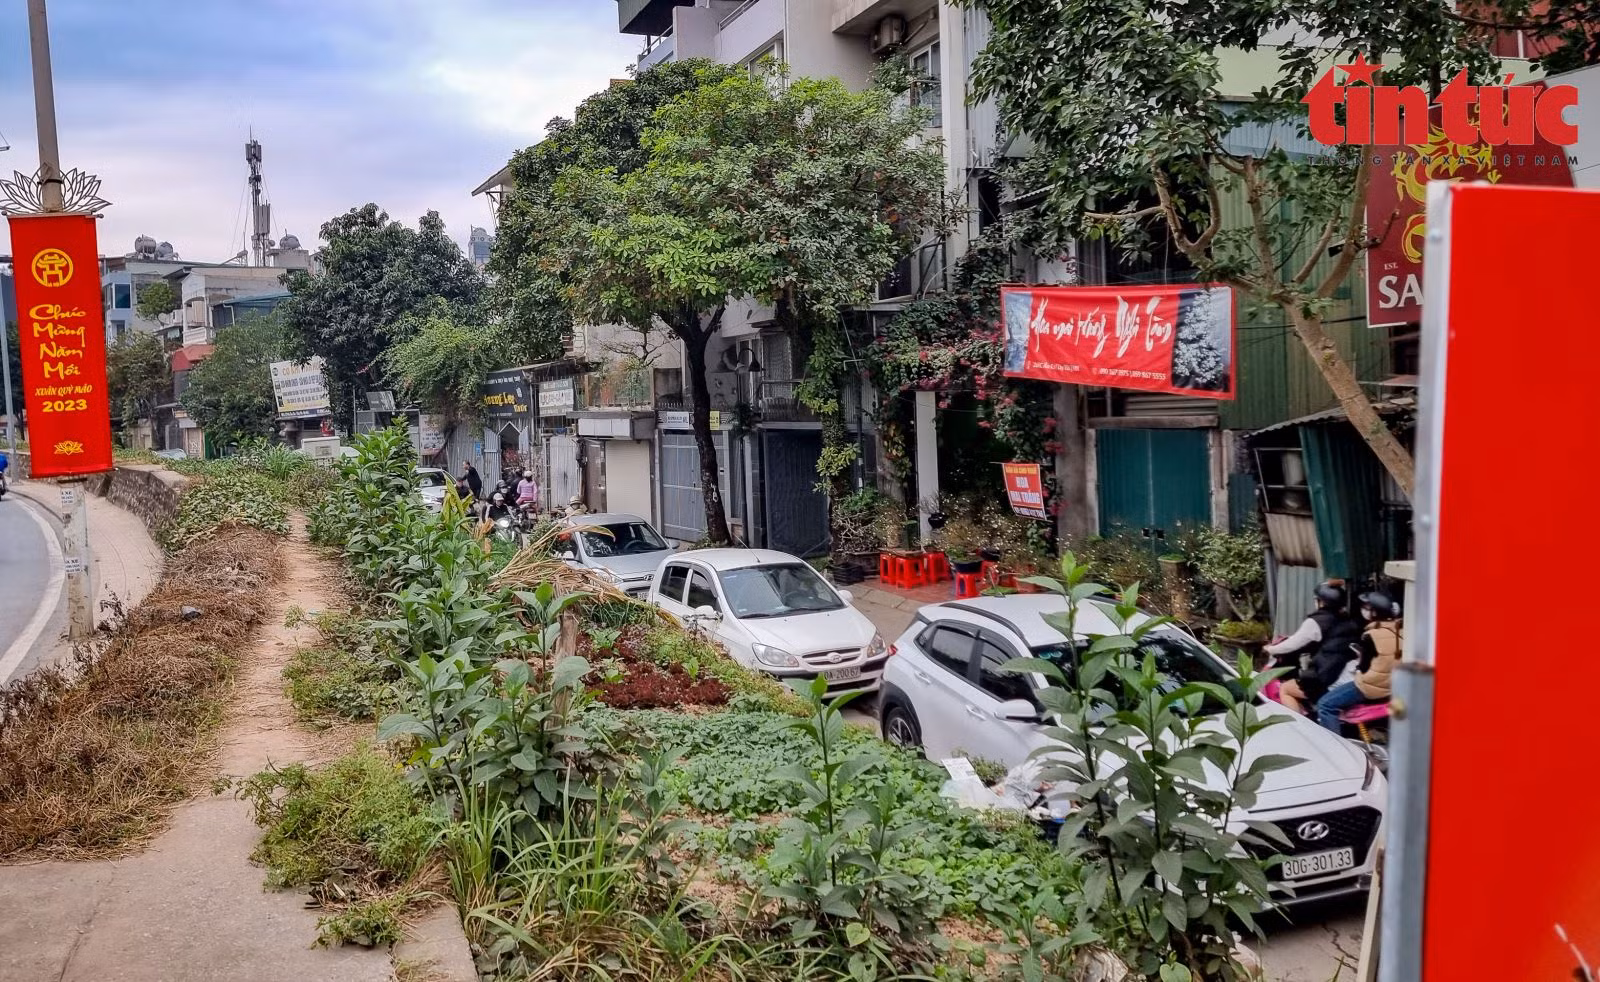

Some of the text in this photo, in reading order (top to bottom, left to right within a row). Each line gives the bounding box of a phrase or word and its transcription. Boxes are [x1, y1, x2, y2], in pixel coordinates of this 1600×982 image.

[1378, 273, 1425, 309] SA
[29, 304, 86, 320] Chúc
[33, 322, 85, 347] Mừng
[40, 341, 82, 360] Năm
[43, 361, 80, 380] Mới
[42, 399, 88, 412] 2023
